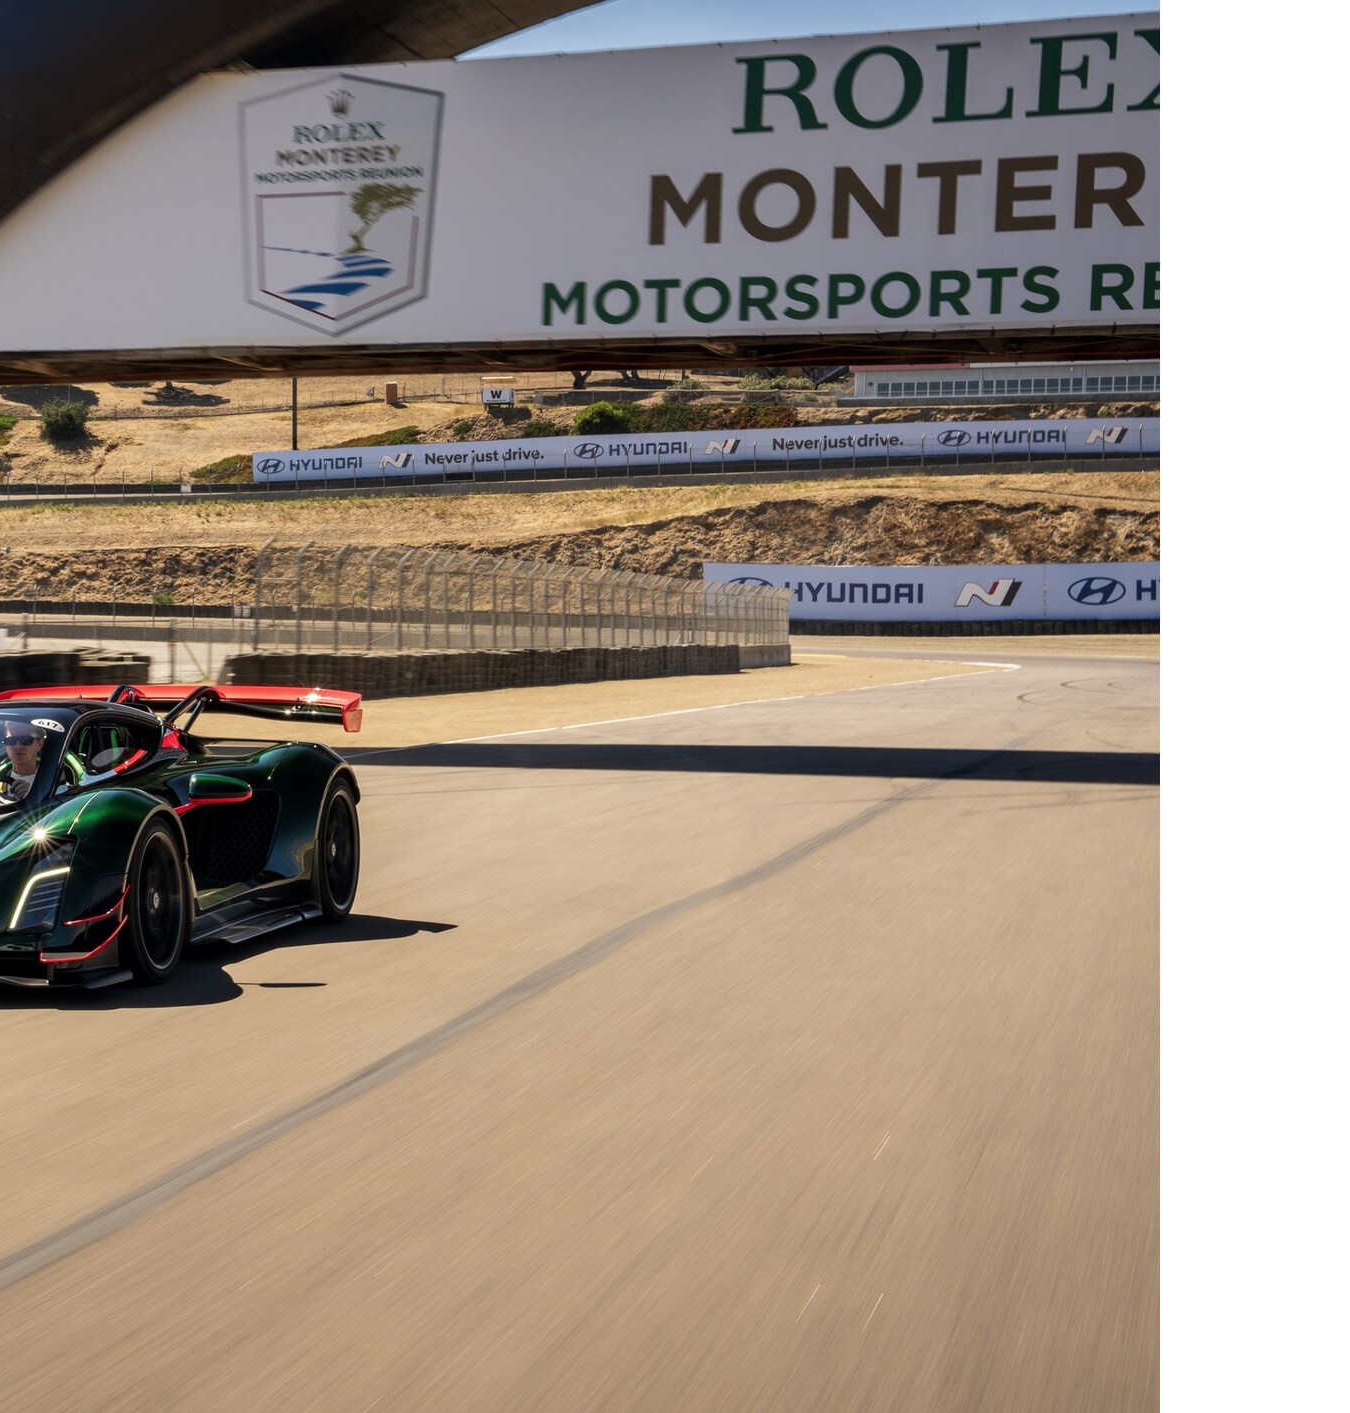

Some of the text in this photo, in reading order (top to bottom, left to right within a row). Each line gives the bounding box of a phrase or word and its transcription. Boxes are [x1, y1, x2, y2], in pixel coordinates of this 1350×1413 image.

[292, 121, 386, 144] ROLEX
[274, 145, 402, 167] MONTEREY
[254, 166, 425, 184] MOTORSPORTS REUNION
[650, 152, 1145, 245] MONTER
[544, 266, 1059, 325] MOTORSPORTS
[490, 390, 502, 399] W
[772, 433, 904, 451] Never just drive.
[977, 429, 1066, 444] HYUNDAI
[425, 447, 545, 466] Never just drive.
[608, 441, 688, 457] HYUNDAI
[290, 456, 363, 472] HYUNDAI
[784, 581, 924, 604] HYUNDAI
[1136, 579, 1160, 601] H
